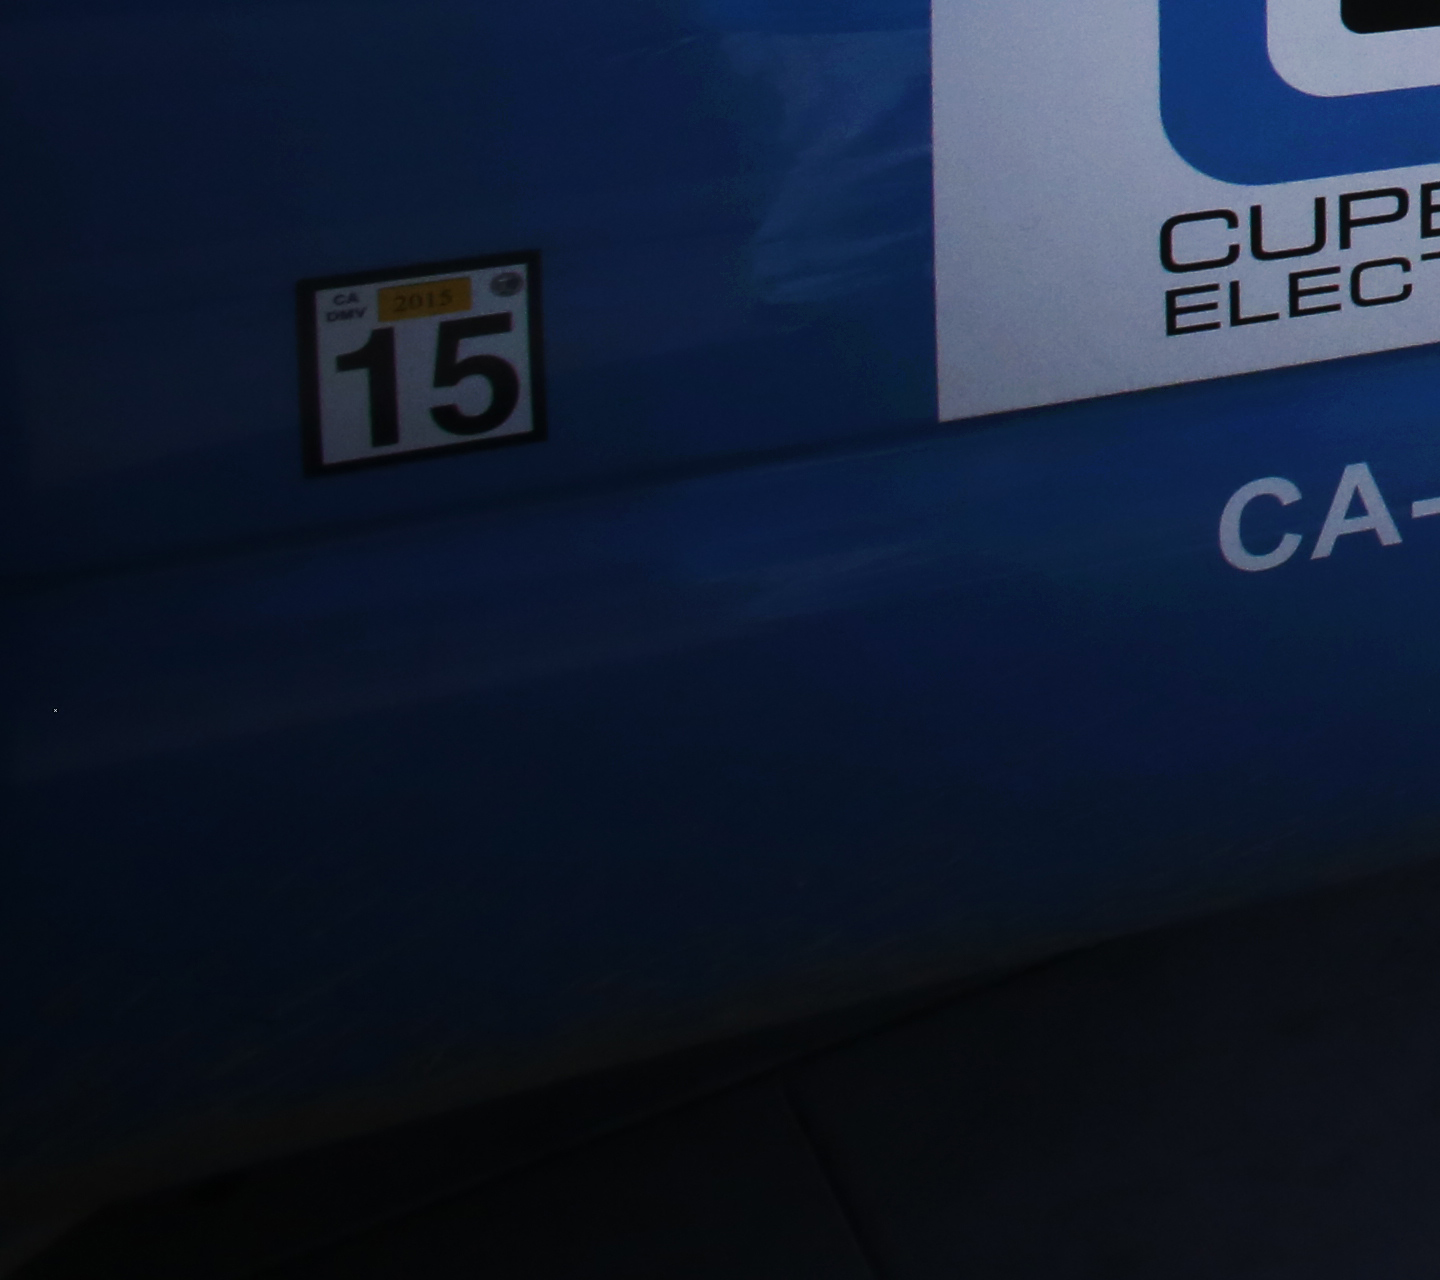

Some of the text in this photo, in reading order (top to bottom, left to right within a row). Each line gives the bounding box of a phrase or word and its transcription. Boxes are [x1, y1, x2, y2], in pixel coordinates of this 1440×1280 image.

[333, 292, 360, 306] CA
[394, 289, 454, 313] 2015
[326, 307, 368, 322] DMV
[335, 311, 521, 448] 15
